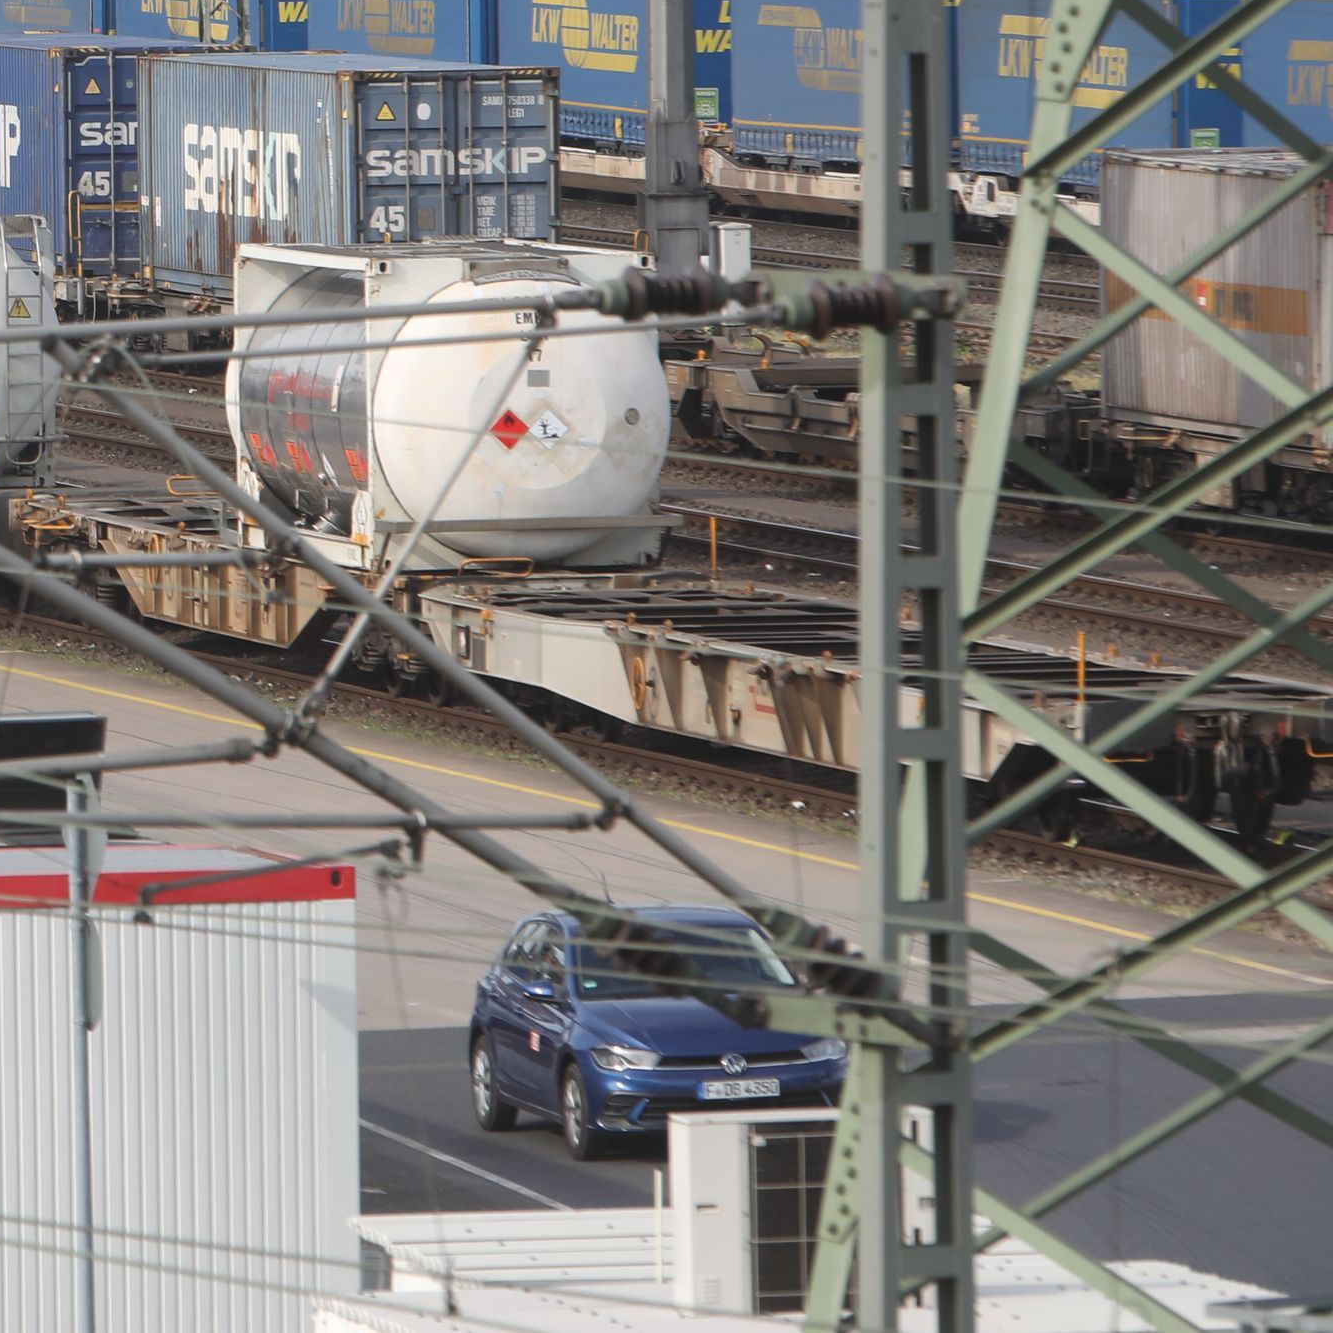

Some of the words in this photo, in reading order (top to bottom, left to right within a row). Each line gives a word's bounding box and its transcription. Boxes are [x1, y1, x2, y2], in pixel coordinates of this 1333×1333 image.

[531, 7, 561, 44] LKW
[590, 12, 639, 52] WALTER
[998, 37, 1030, 78] LKW
[77, 170, 110, 197] 45
[369, 205, 406, 233] 45
